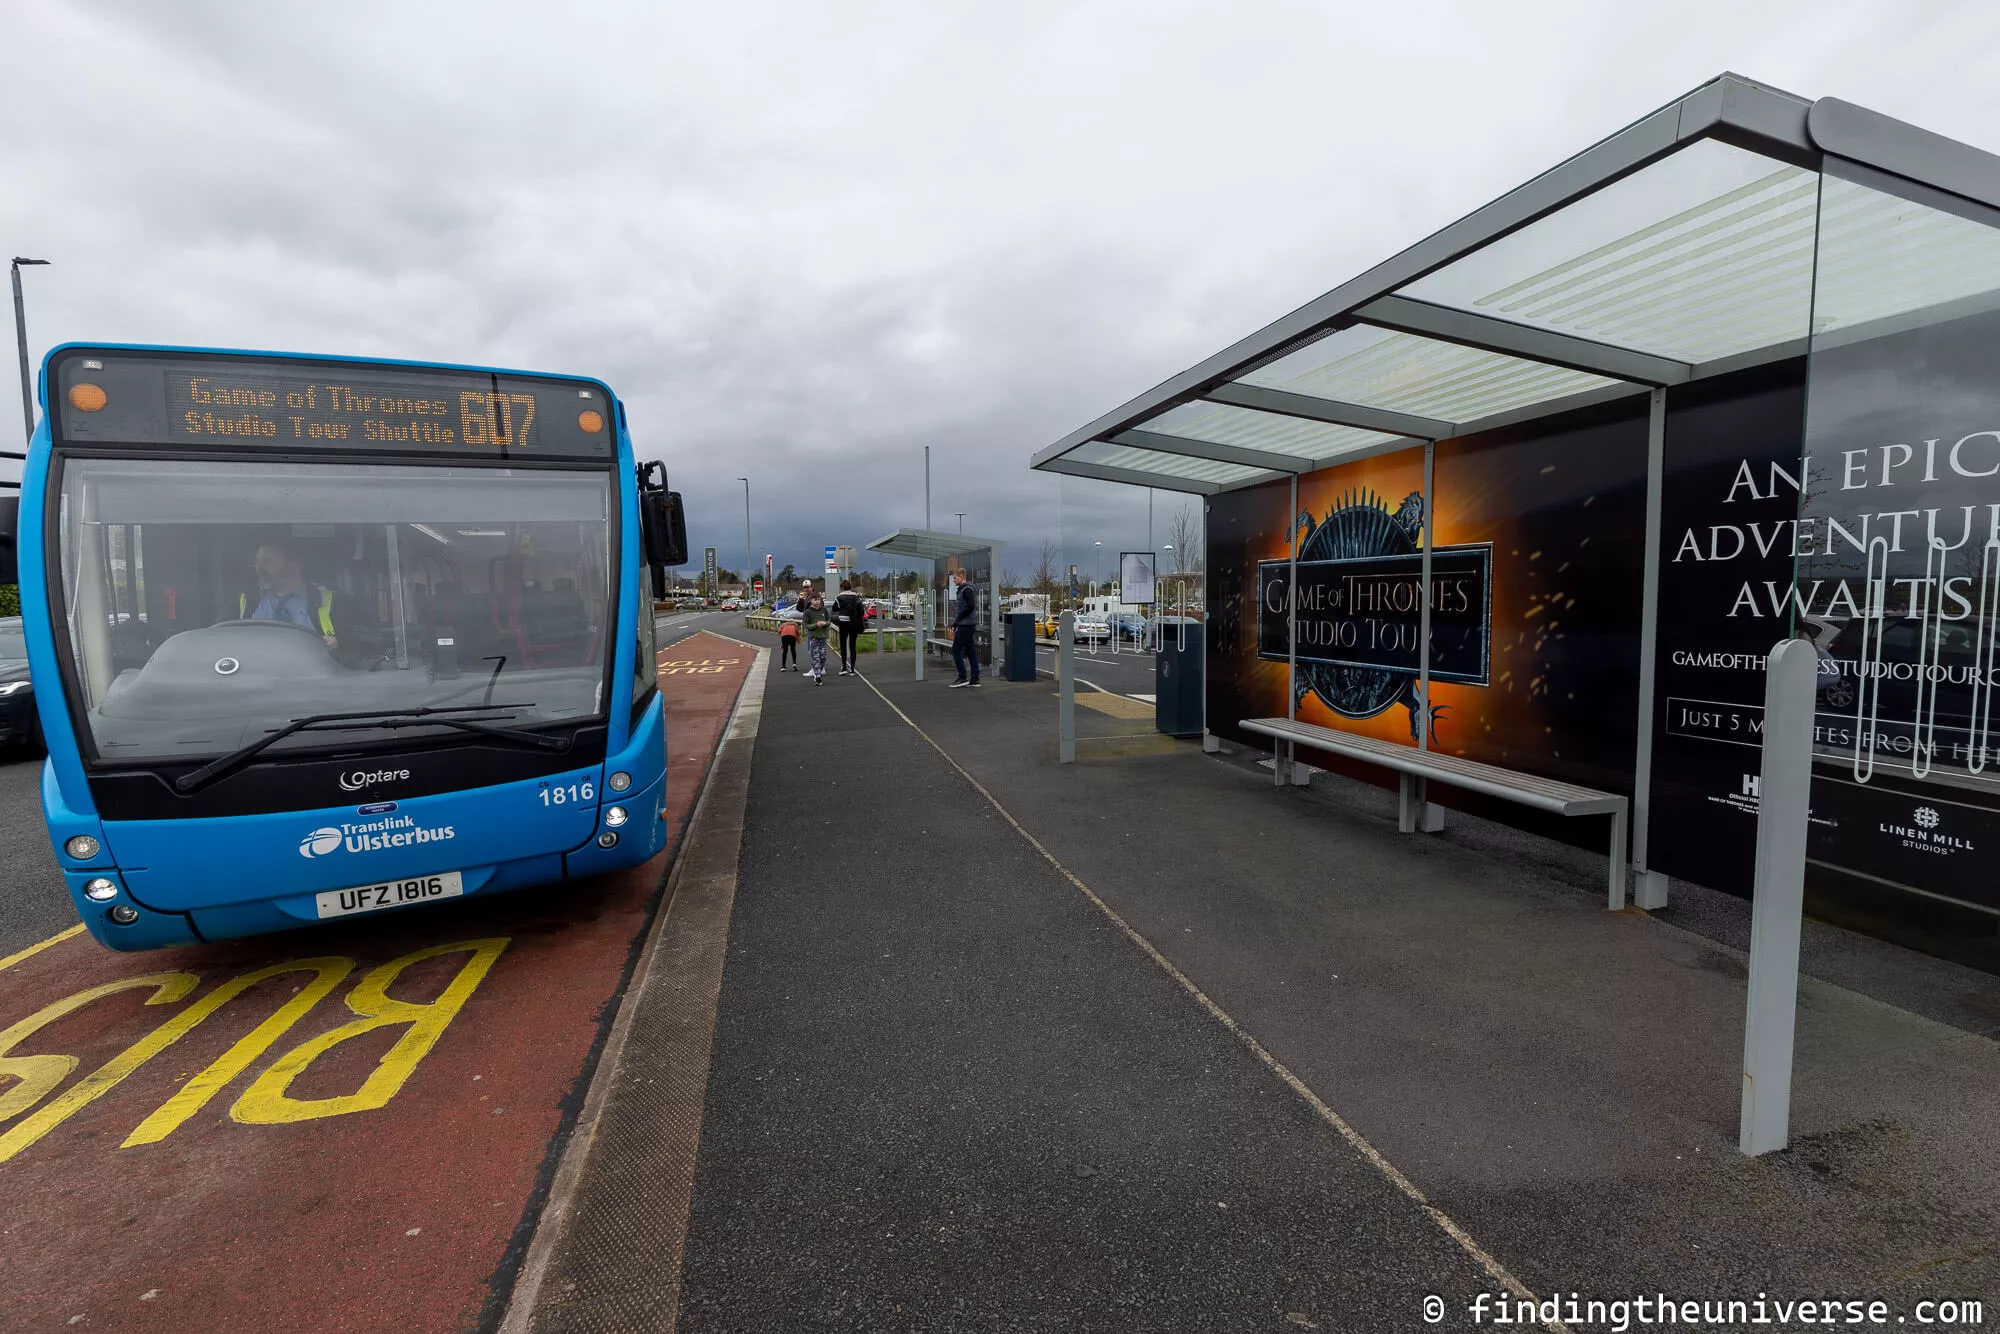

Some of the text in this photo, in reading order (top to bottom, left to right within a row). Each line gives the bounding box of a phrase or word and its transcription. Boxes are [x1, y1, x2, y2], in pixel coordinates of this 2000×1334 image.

[190, 377, 447, 415] Game of Thrones
[184, 410, 455, 443] Studio Tour Shuttle
[460, 391, 536, 446] 607
[1722, 431, 2000, 503] AN EPIC
[1342, 571, 1474, 616] THRONES
[1726, 577, 1972, 621] AWAITS
[1365, 618, 1434, 652] TOU
[1680, 708, 1723, 729] JUST
[1730, 714, 1740, 730] 5
[1862, 731, 1938, 757] FROM
[1952, 742, 2000, 766] HE
[350, 768, 410, 788] Optare
[539, 783, 594, 806] 1816
[341, 816, 414, 834] Translink
[345, 825, 455, 853] Ulsterbus
[1879, 823, 1975, 850] LINEN MILL
[339, 877, 443, 910] UFZ 1816
[0, 936, 511, 1164] BUS
